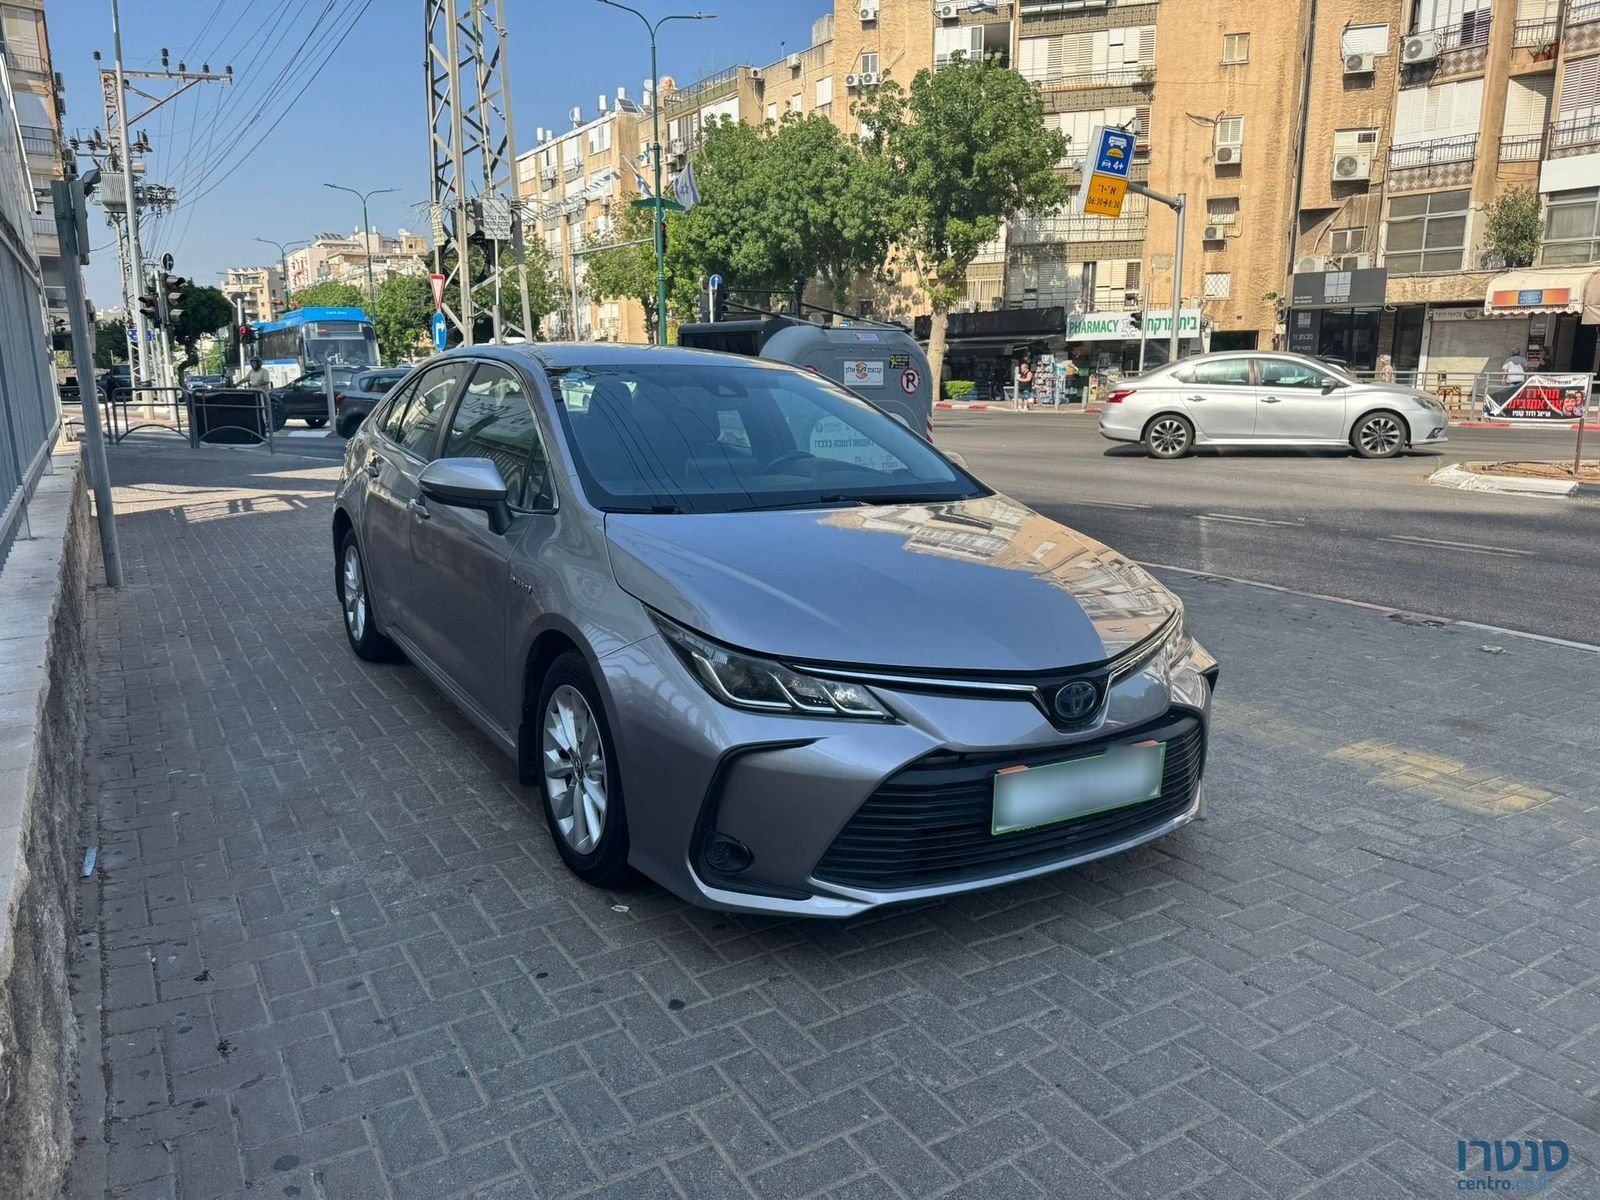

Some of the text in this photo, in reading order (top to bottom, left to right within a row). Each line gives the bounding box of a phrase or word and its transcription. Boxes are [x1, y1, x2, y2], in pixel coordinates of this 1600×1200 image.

[1113, 160, 1124, 170] 4+
[1069, 319, 1119, 334] PHARMACY
[1179, 316, 1197, 330] בית
